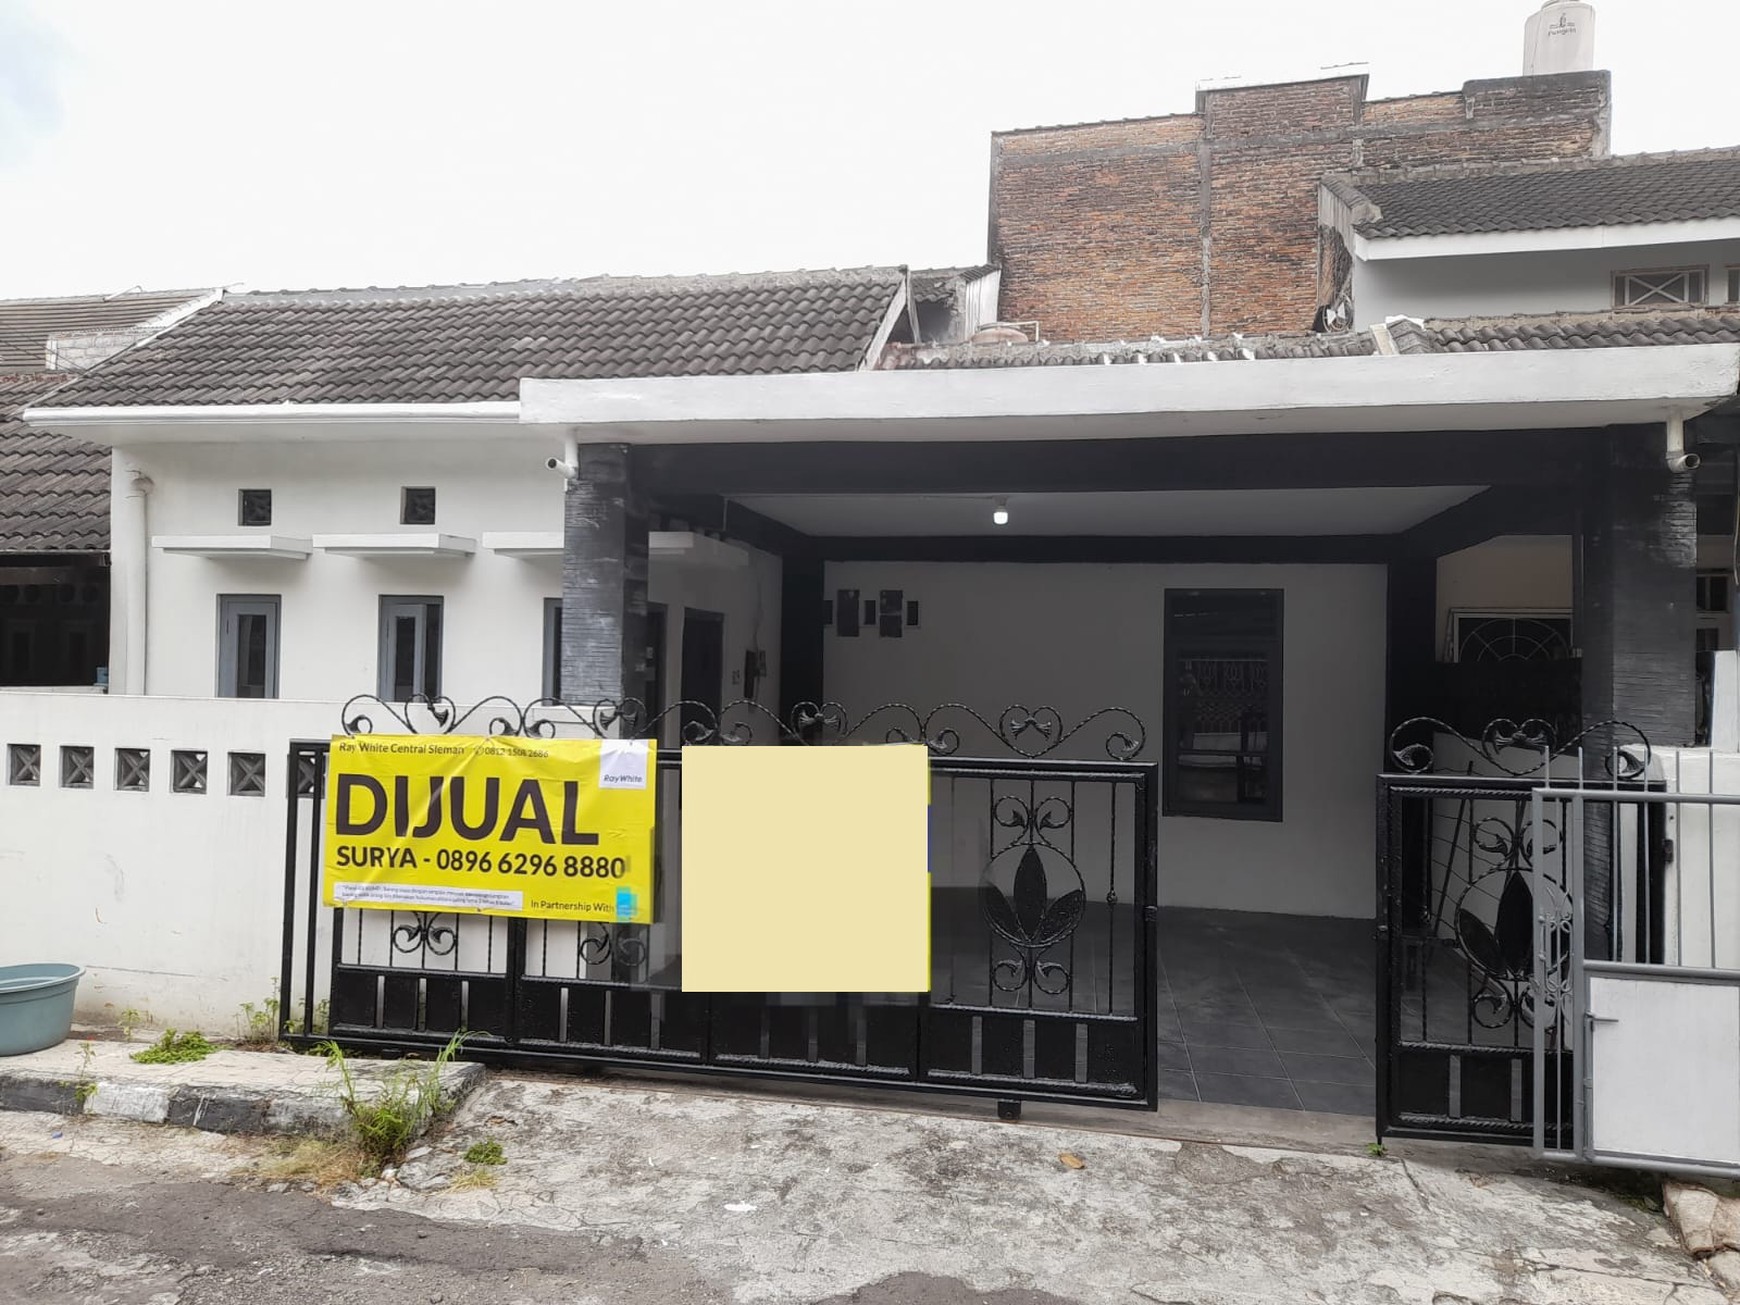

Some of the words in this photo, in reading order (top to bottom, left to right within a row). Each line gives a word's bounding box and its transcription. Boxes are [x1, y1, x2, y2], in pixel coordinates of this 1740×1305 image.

[339, 742, 356, 754] Ray
[359, 743, 389, 753] White
[390, 743, 426, 753] Central
[428, 744, 465, 754] Sleman
[528, 749, 549, 758] 2686
[336, 773, 600, 846] DIJUAL
[336, 845, 418, 868] SURYA
[436, 849, 493, 873] 0896
[497, 852, 557, 877] 6296
[564, 855, 625, 879] 8880
[531, 899, 540, 909] In
[540, 900, 592, 912] Partnership
[593, 903, 615, 912] With
